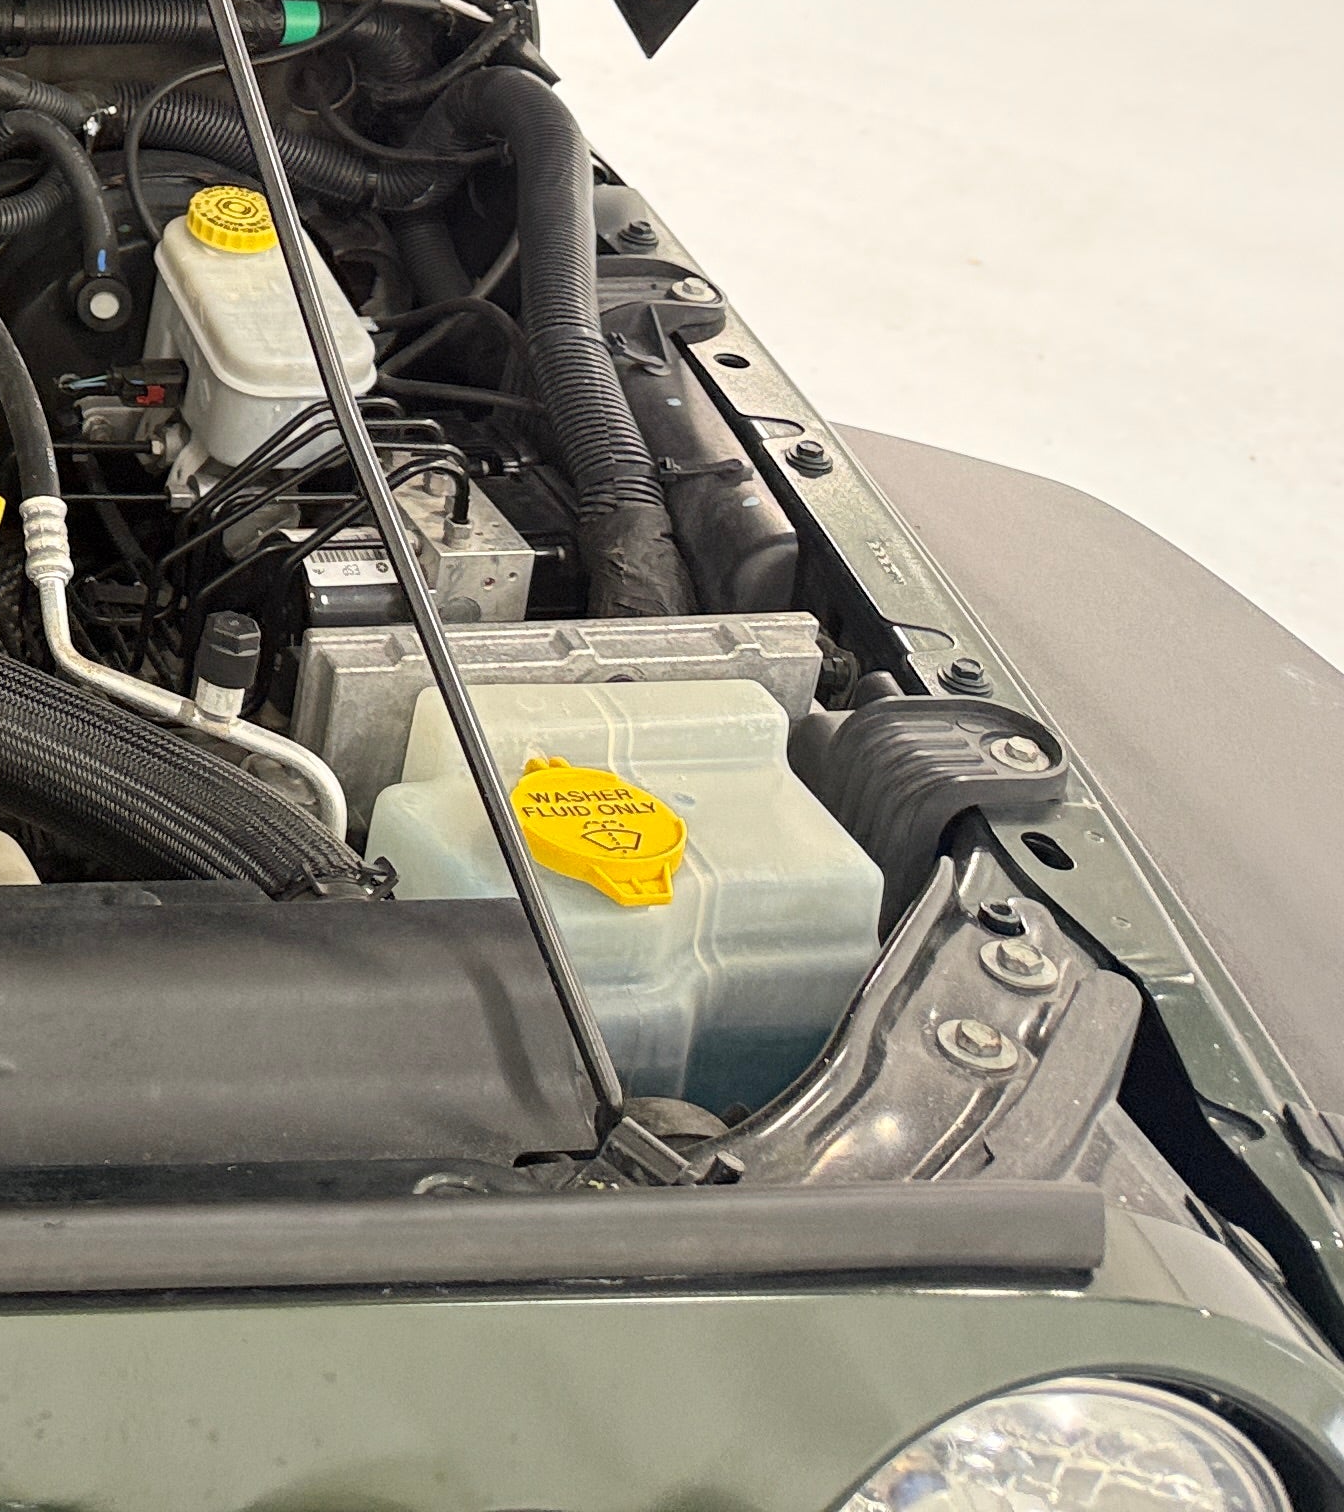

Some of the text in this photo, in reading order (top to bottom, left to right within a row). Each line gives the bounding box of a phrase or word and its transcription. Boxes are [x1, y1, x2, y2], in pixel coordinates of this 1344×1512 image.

[528, 788, 634, 804] WASHER
[522, 801, 657, 818] FLUID ONLY
